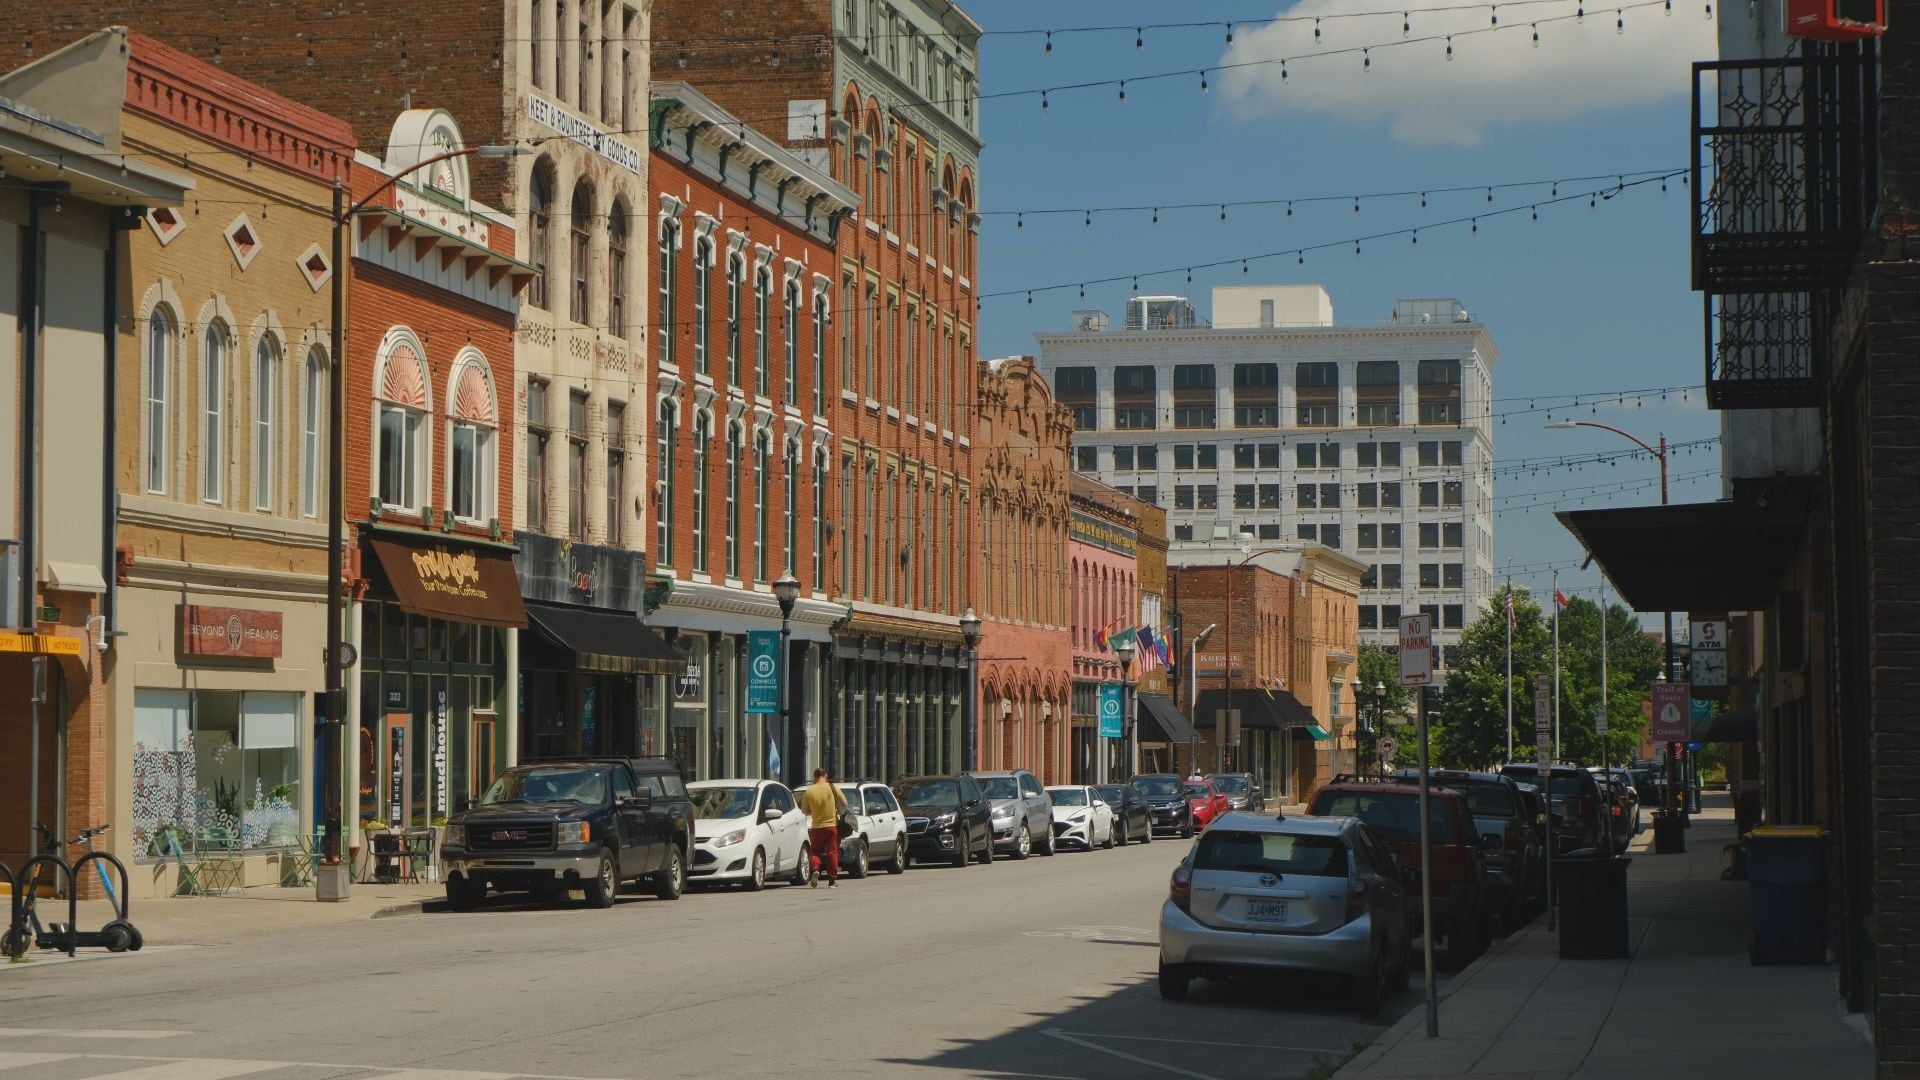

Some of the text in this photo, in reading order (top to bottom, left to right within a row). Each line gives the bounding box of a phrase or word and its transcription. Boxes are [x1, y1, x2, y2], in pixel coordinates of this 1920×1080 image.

[530, 95, 549, 123] KEET
[551, 106, 556, 127] &
[557, 109, 591, 147] ROUNTREE
[607, 137, 628, 166] GOODS
[191, 624, 279, 640] BEYOND HEALING
[1408, 621, 1421, 634] NO
[1401, 636, 1430, 650] PARKING
[1200, 653, 1240, 662] KRESGE
[1655, 684, 1685, 693] Trail of
[389, 691, 401, 701] 323
[1657, 728, 1686, 737] Crossing
[435, 691, 447, 812] mudhouse
[491, 830, 528, 841] GMC
